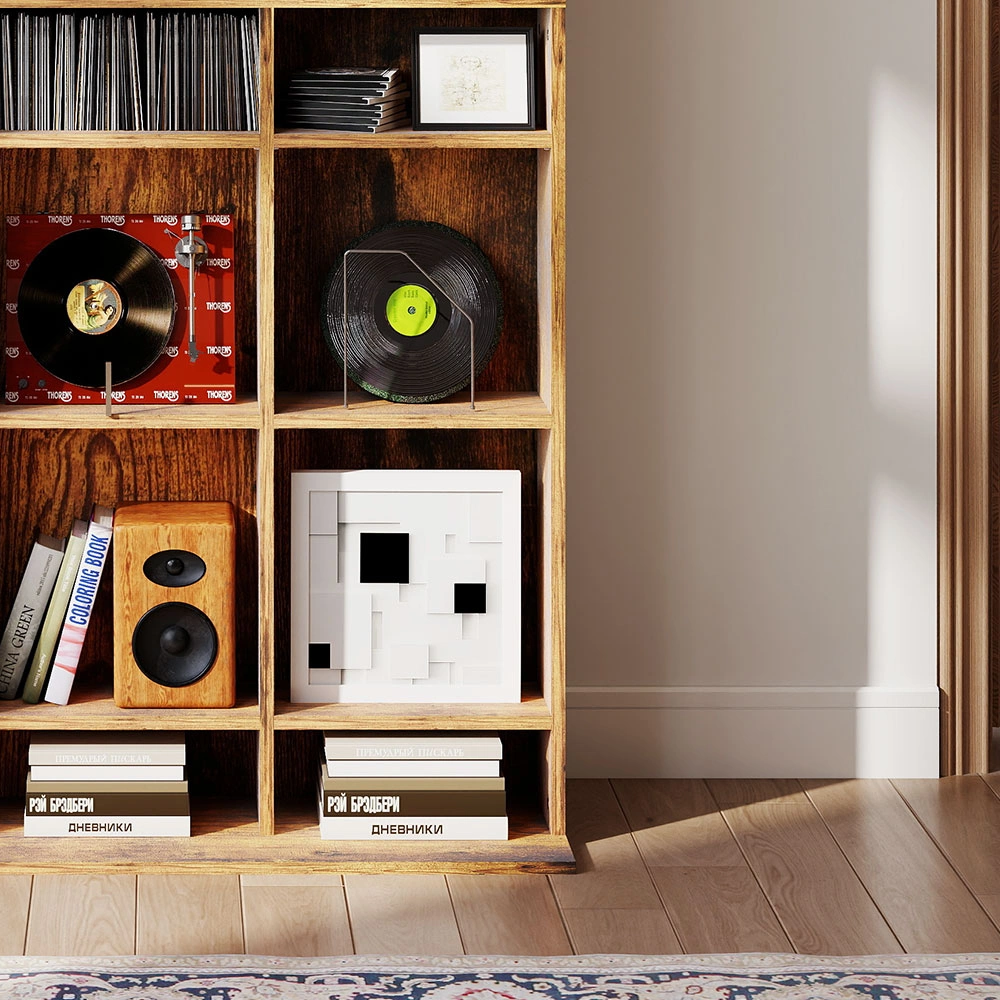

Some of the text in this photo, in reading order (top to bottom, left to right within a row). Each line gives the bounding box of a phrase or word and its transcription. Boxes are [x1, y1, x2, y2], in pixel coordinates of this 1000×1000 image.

[48, 214, 72, 226] THORENS
[101, 214, 125, 226] THORENS
[153, 214, 178, 226] THORENS
[205, 214, 230, 226] THORENS
[206, 258, 231, 269] THORENS
[206, 302, 231, 313] THORENS
[207, 346, 232, 357] THORENS
[47, 391, 72, 403] THORENS
[100, 391, 126, 402] THRENS
[154, 390, 179, 402] THORENS
[207, 390, 232, 402] THORENS
[69, 534, 109, 625] COLORING BOOK
[12, 604, 35, 648] GREEN
[29, 795, 94, 814] РЭЙ БРЭДБЕРИ
[327, 792, 400, 814] РЭЙ БРЭДБЕРИ
[68, 823, 133, 833] ДНЕВНИКИ
[371, 824, 443, 835] ДНЕВНИКИ
